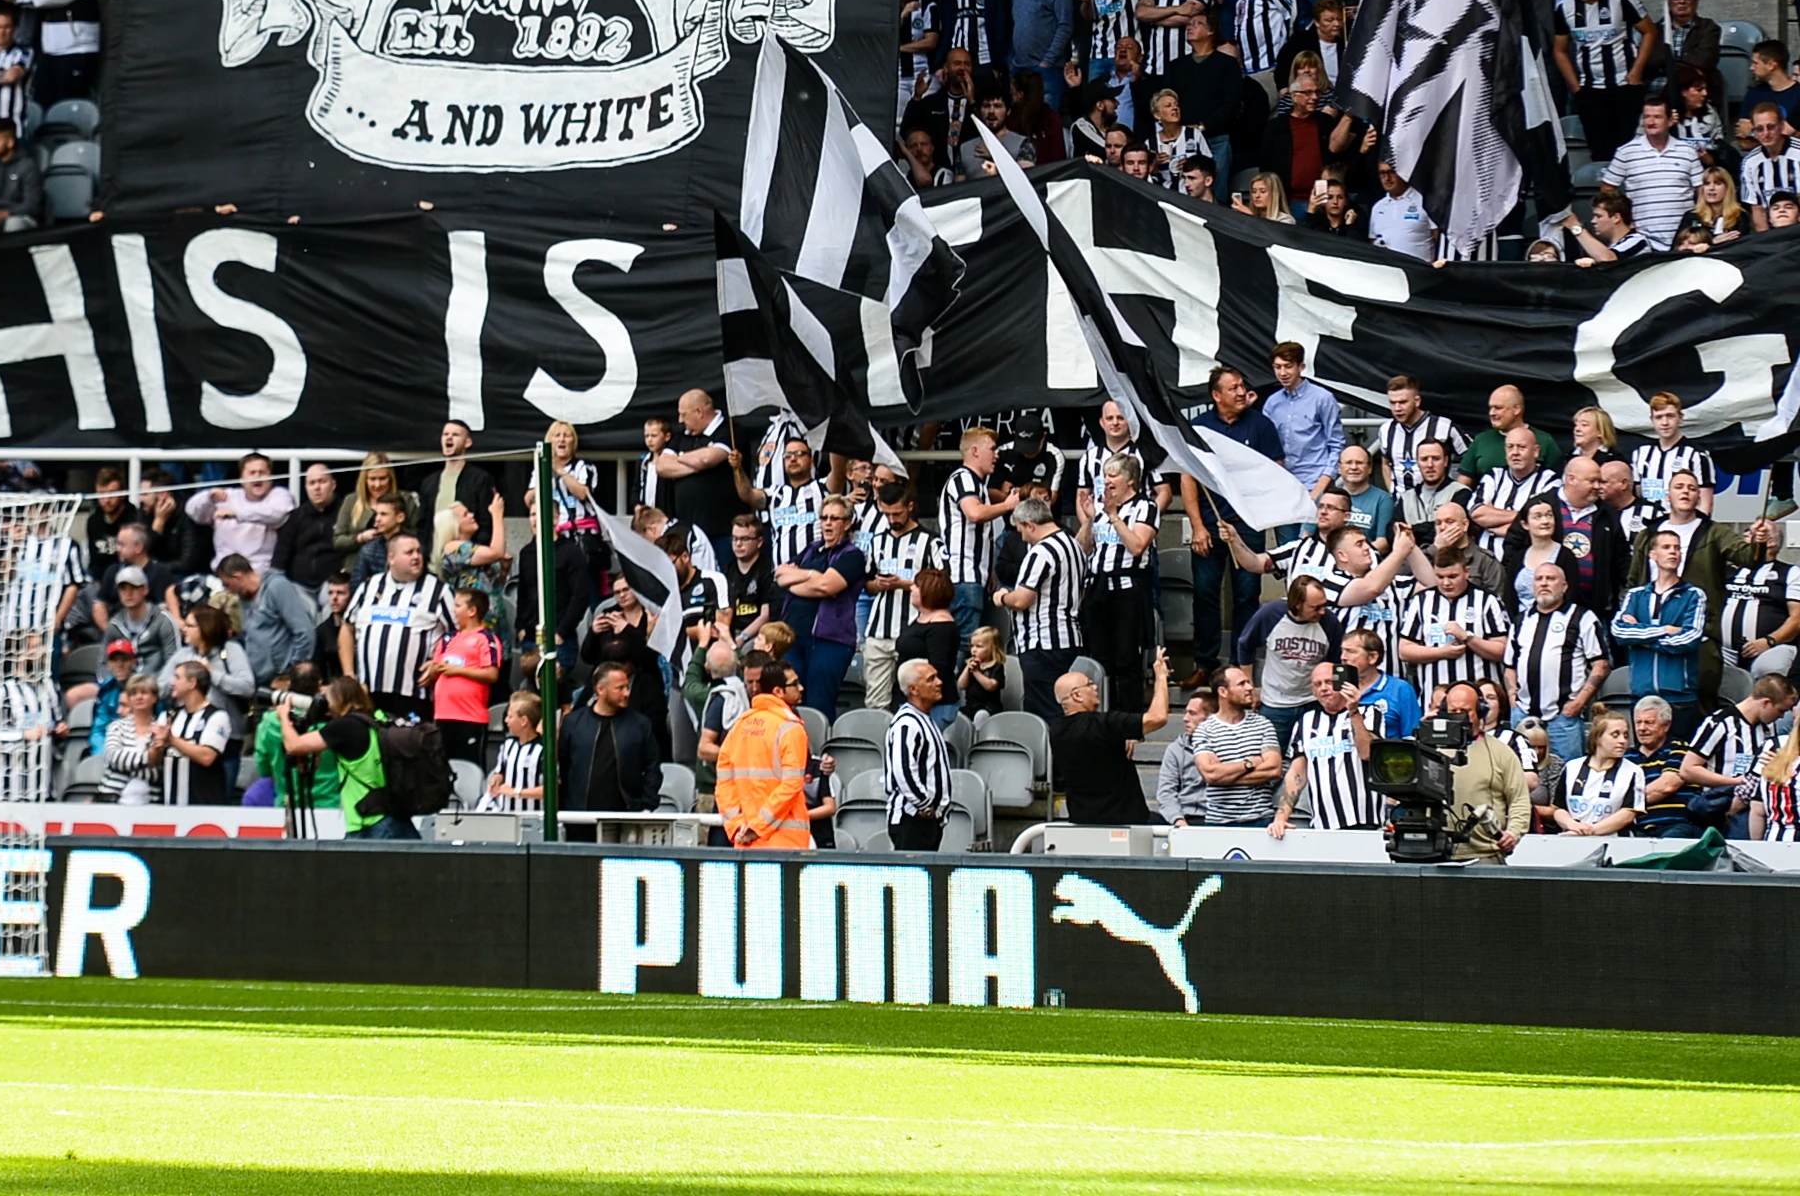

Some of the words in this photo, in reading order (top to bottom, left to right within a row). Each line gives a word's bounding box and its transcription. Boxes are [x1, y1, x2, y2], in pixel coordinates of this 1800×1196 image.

[386, 10, 474, 55] EST.
[517, 14, 631, 61] 1892
[520, 81, 675, 146] WHITE
[444, 229, 646, 432] IS
[1274, 637, 1326, 655] BOSTON
[598, 857, 1036, 1009] PUMA
